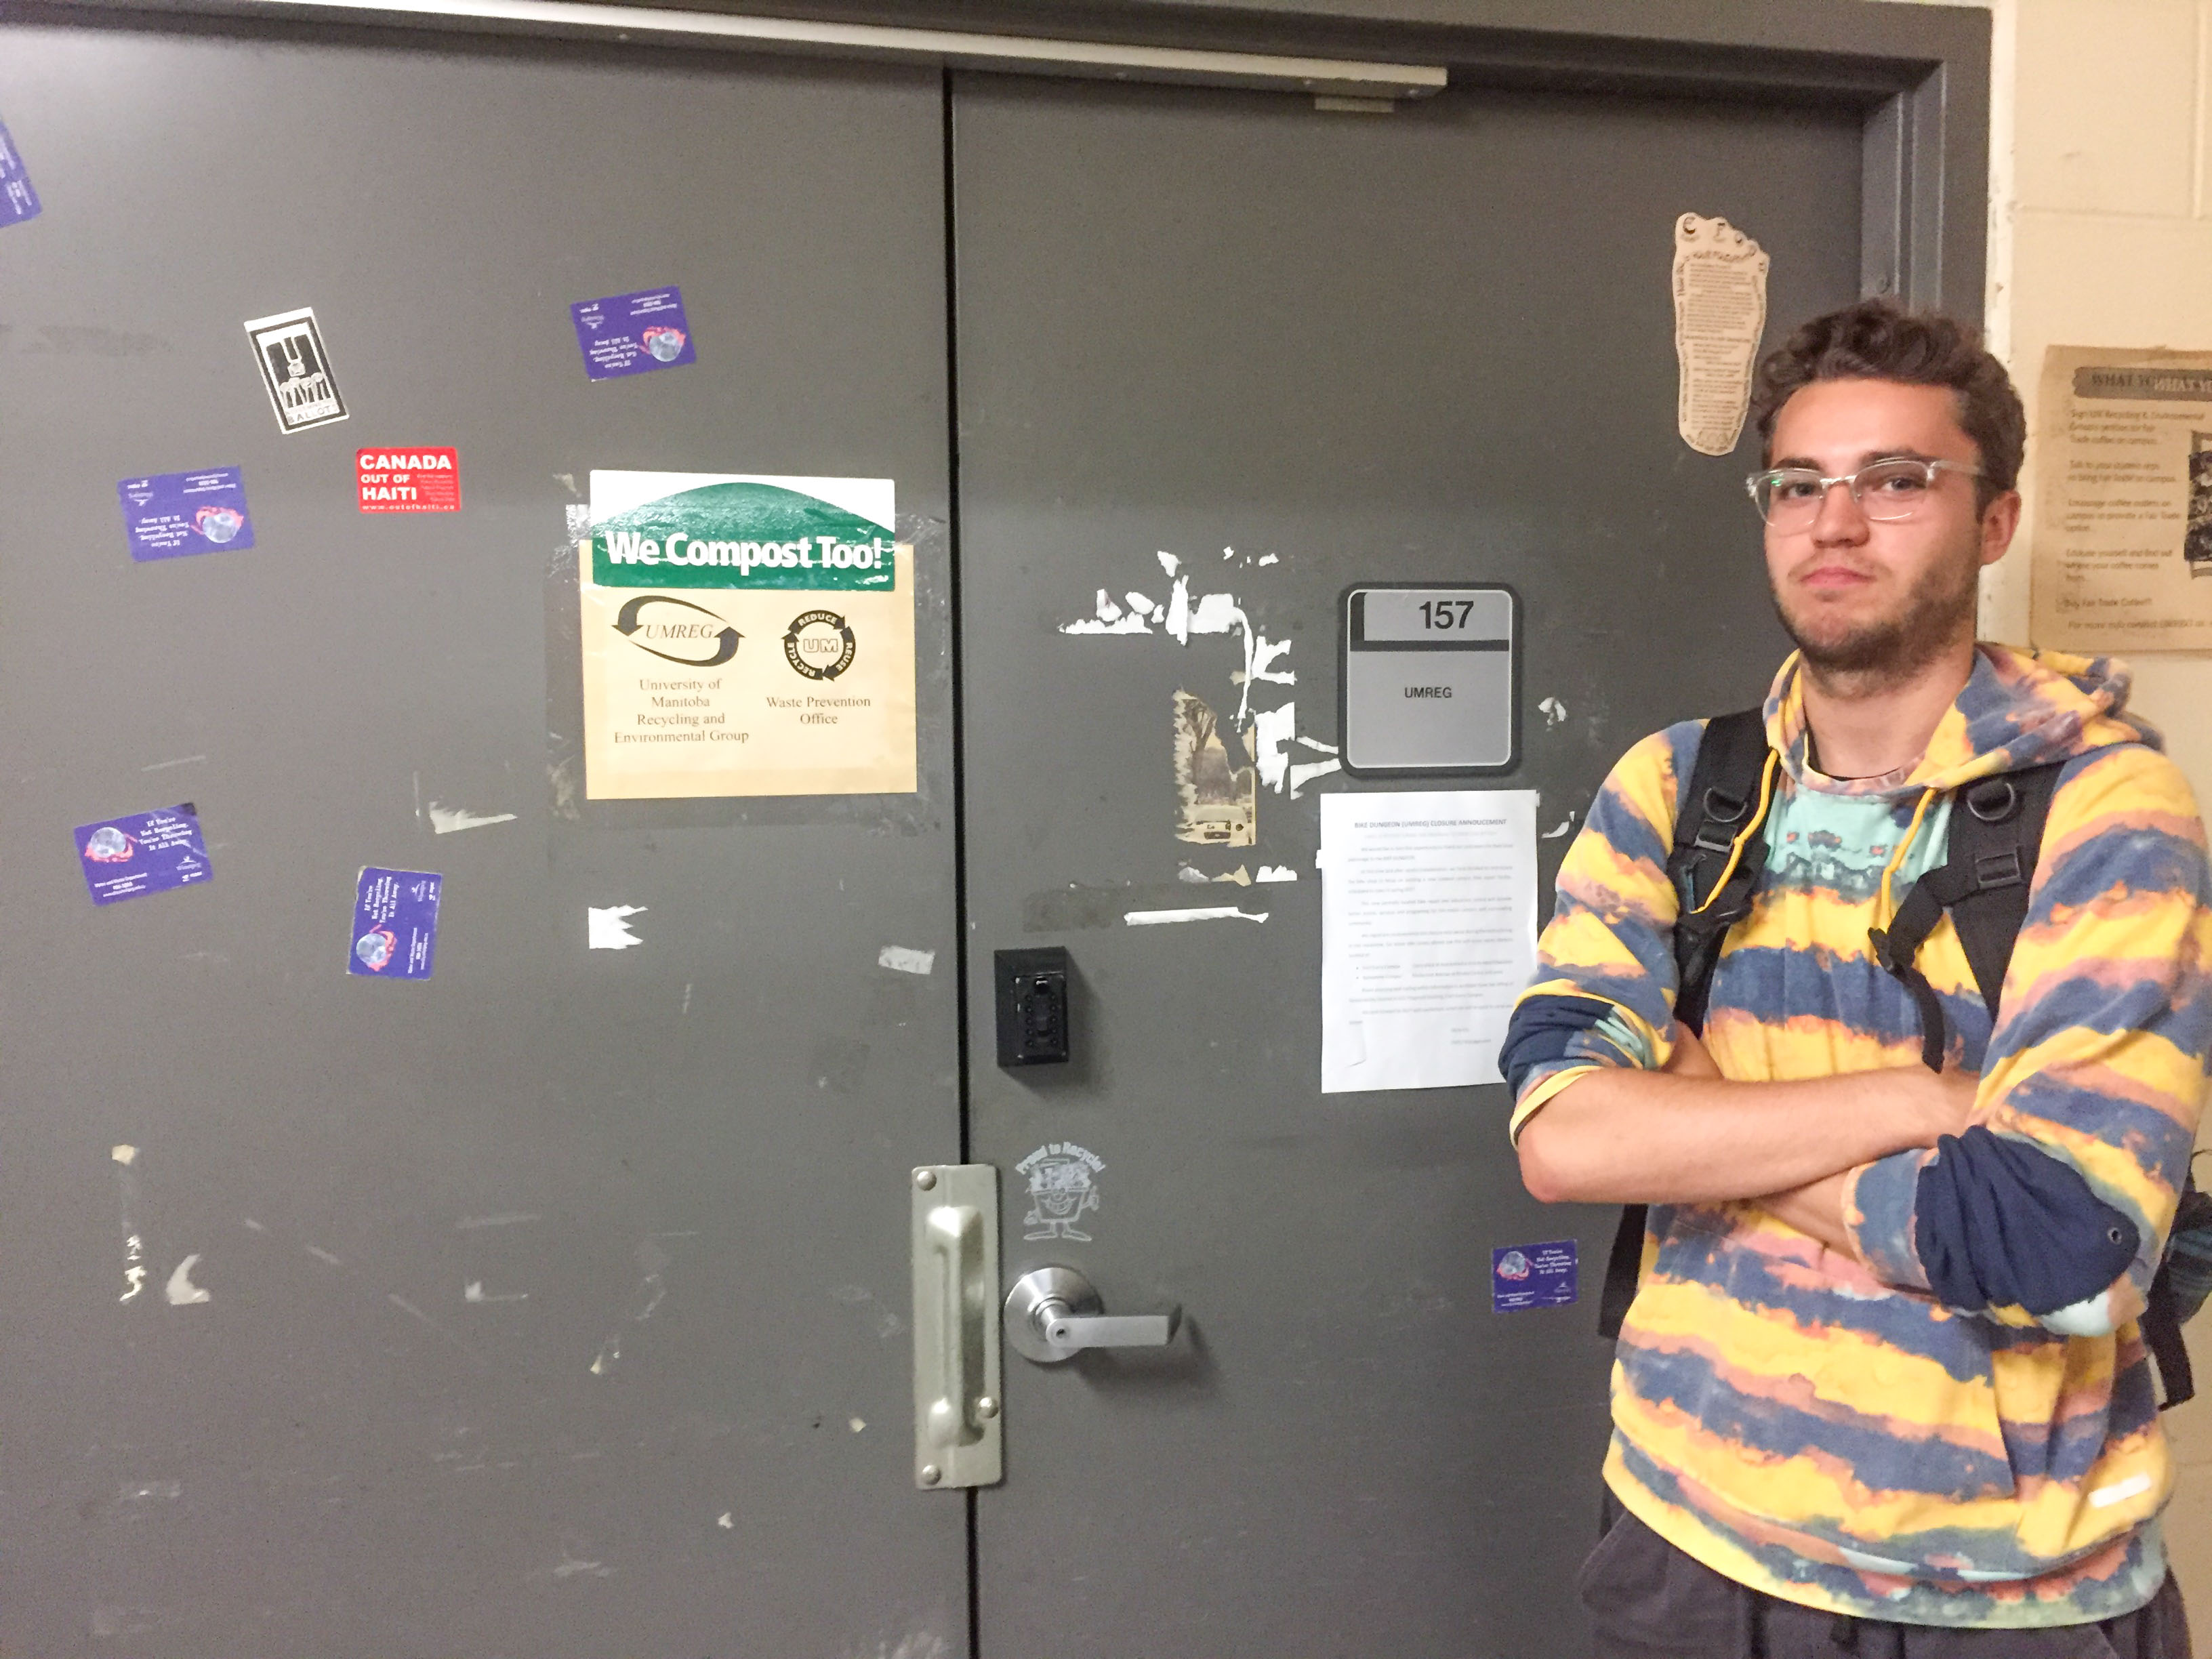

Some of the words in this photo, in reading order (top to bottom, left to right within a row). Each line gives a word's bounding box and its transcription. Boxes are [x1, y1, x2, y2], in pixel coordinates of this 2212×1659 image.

[359, 455, 451, 470] CANADA
[361, 474, 389, 483] OUT
[393, 474, 410, 483] OF
[362, 487, 417, 500] HAITI
[605, 531, 660, 565] We
[665, 533, 812, 575] Compost
[813, 536, 881, 569] Too!
[798, 613, 838, 626] REDUCE
[1419, 600, 1474, 629] 157
[644, 624, 714, 638] UMREG
[803, 639, 838, 653] UM
[787, 642, 816, 677] RECYCLE
[836, 642, 853, 671] REUSE
[639, 678, 703, 692] University
[708, 678, 722, 691] of
[1404, 687, 1452, 698] UMREG
[651, 697, 710, 708] Manitoba
[766, 697, 802, 708] Waste
[806, 697, 871, 708] Prevention
[637, 714, 699, 726] Recycling
[703, 713, 725, 724] and
[800, 714, 838, 724] Office
[614, 731, 705, 743] Environmental
[710, 731, 749, 744] Group
[1048, 1144, 1061, 1155] to
